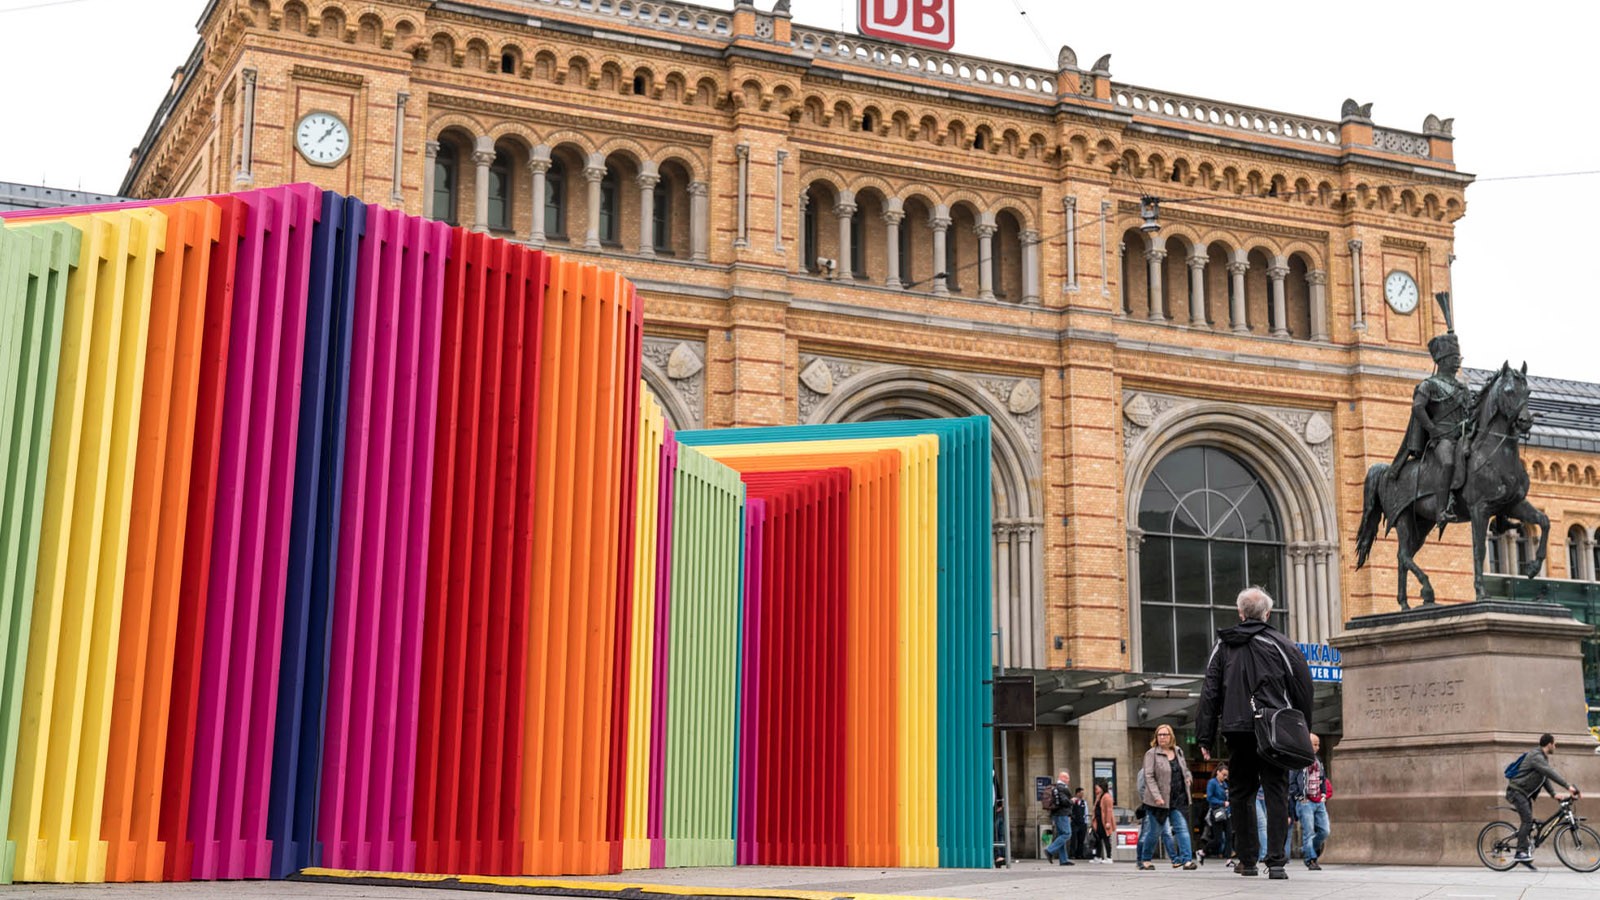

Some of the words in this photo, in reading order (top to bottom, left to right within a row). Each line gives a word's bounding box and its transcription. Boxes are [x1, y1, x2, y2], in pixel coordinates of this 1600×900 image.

[873, 0, 945, 35] DB
[1295, 643, 1340, 662] NKAU
[1366, 683, 1410, 703] ERNST
[1410, 679, 1464, 700] AUGUST
